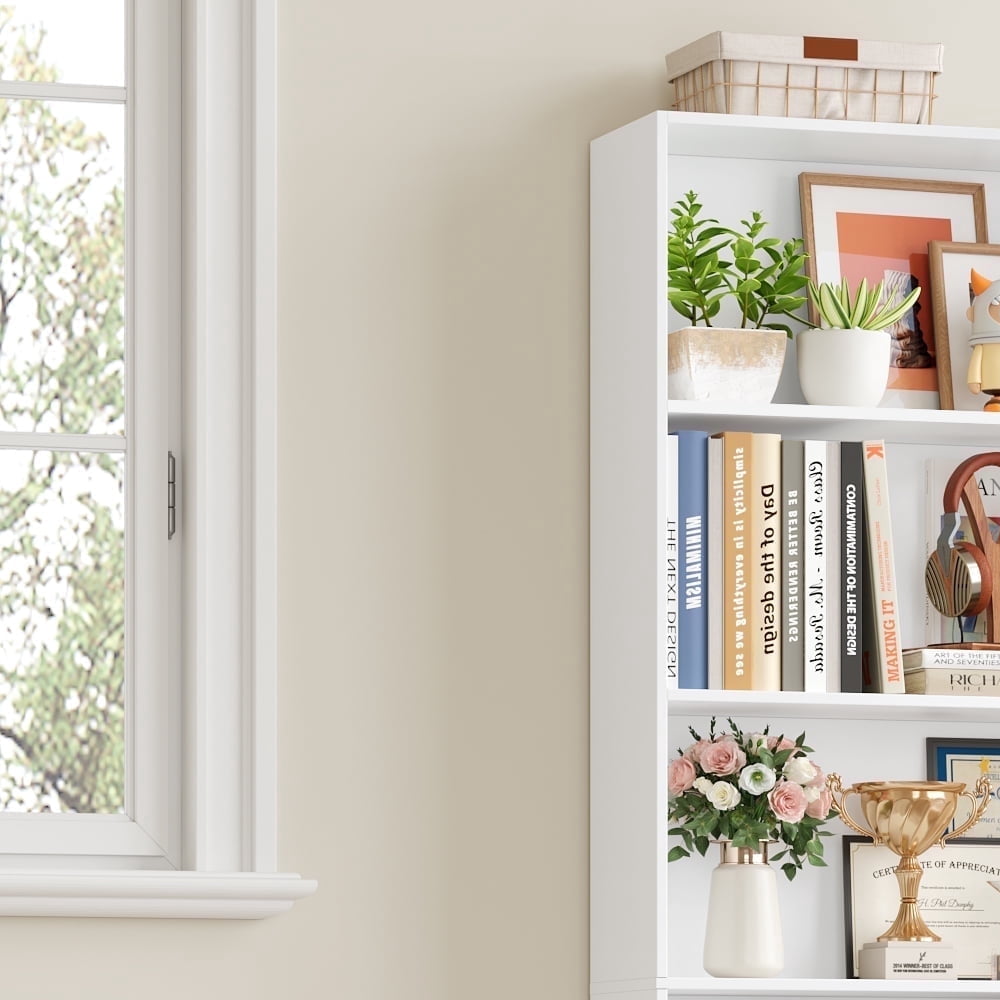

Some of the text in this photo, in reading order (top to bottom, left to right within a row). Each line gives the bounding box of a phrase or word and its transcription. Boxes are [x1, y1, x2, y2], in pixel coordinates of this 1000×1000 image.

[881, 600, 894, 615] IT
[883, 618, 900, 683] MAKING
[872, 861, 932, 879] CERTTE
[934, 860, 946, 869] OF
